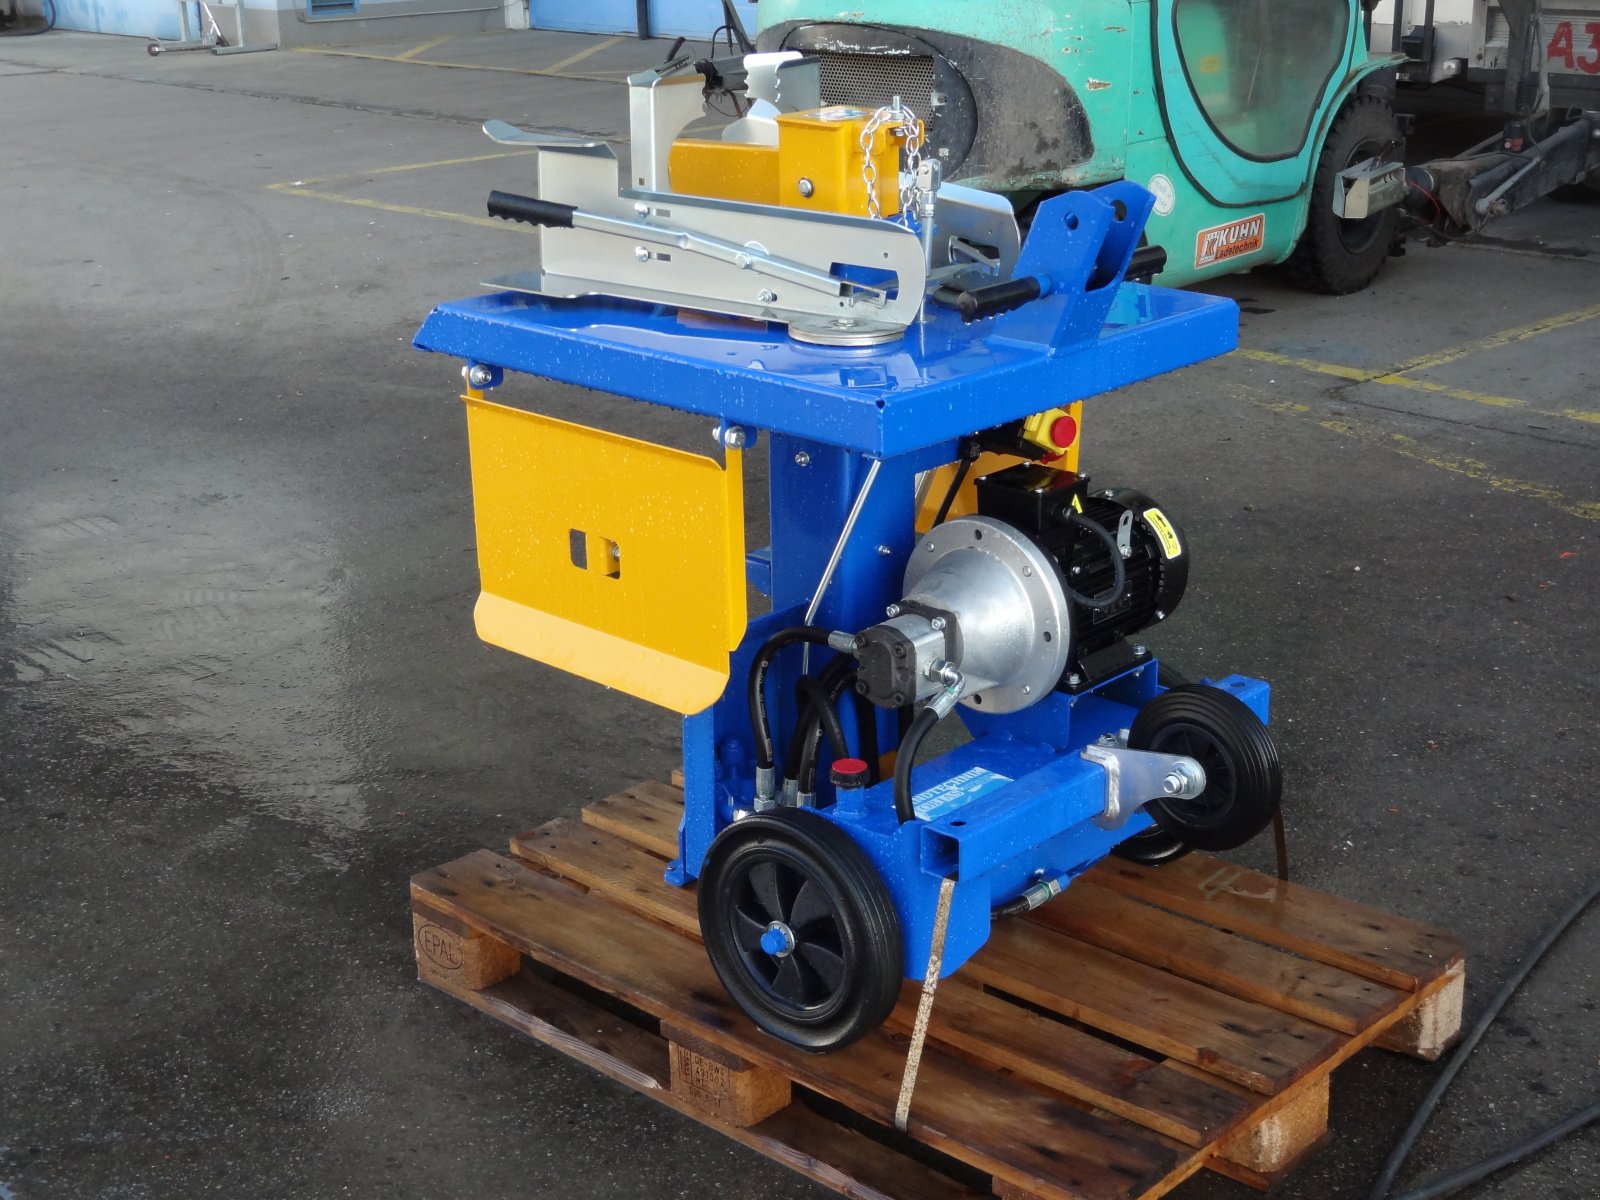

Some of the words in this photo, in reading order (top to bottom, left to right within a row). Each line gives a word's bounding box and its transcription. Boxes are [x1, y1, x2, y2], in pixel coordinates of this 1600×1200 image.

[1218, 219, 1261, 247] KUHN
[1215, 238, 1259, 260] Ladetechnik
[912, 767, 984, 805] NDTECHNIK
[424, 930, 458, 965] EPAL
